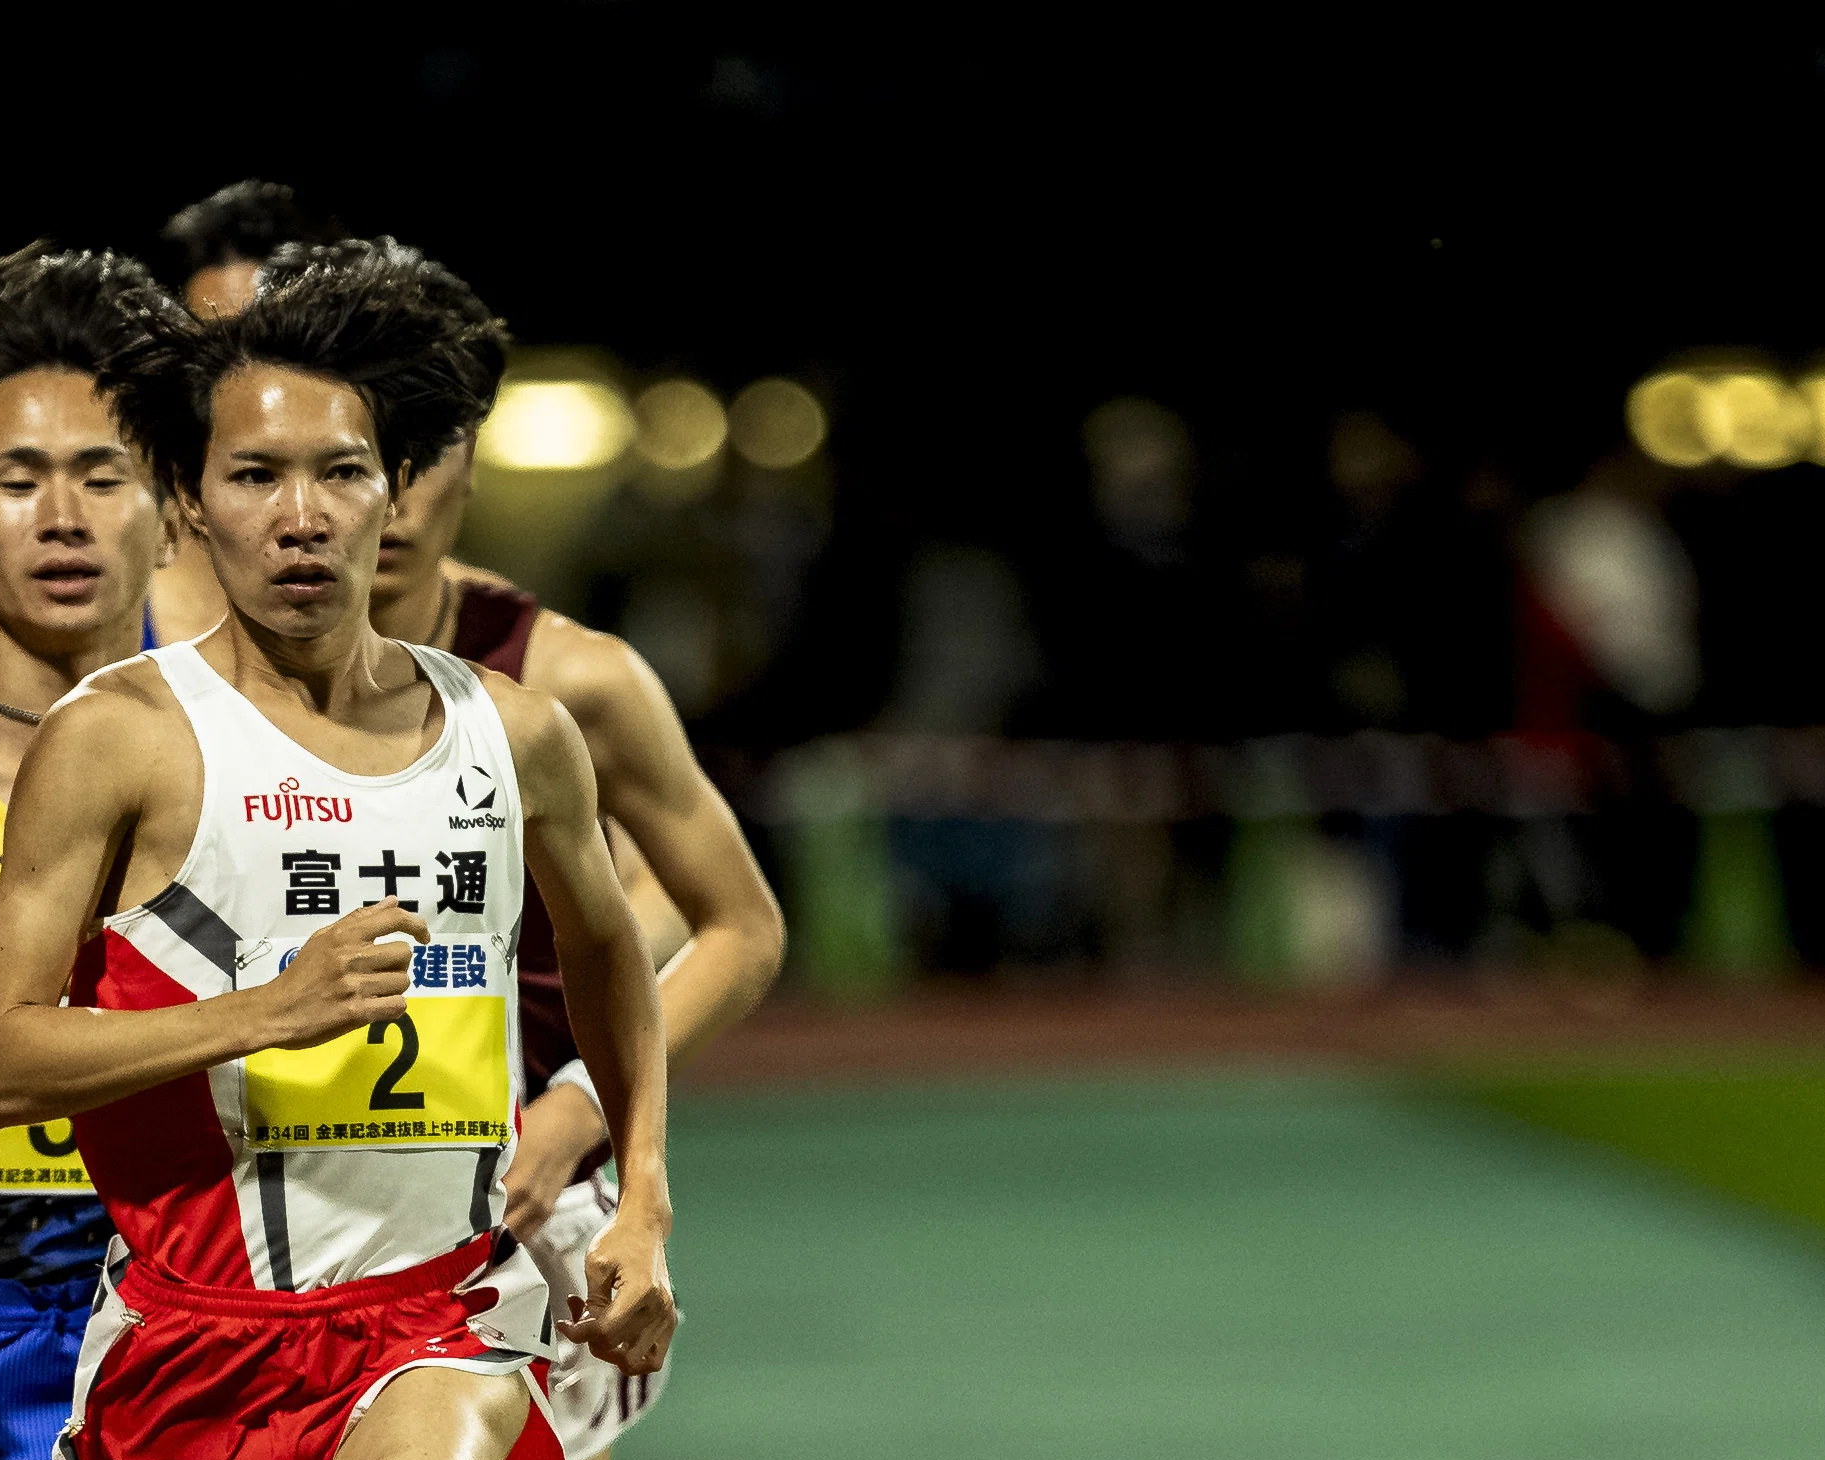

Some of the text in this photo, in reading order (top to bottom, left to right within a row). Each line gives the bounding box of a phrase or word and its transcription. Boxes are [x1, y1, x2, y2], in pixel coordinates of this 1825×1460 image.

[243, 792, 353, 831] FUJITSU
[281, 849, 488, 915] 富士通
[367, 1010, 426, 1111] 2
